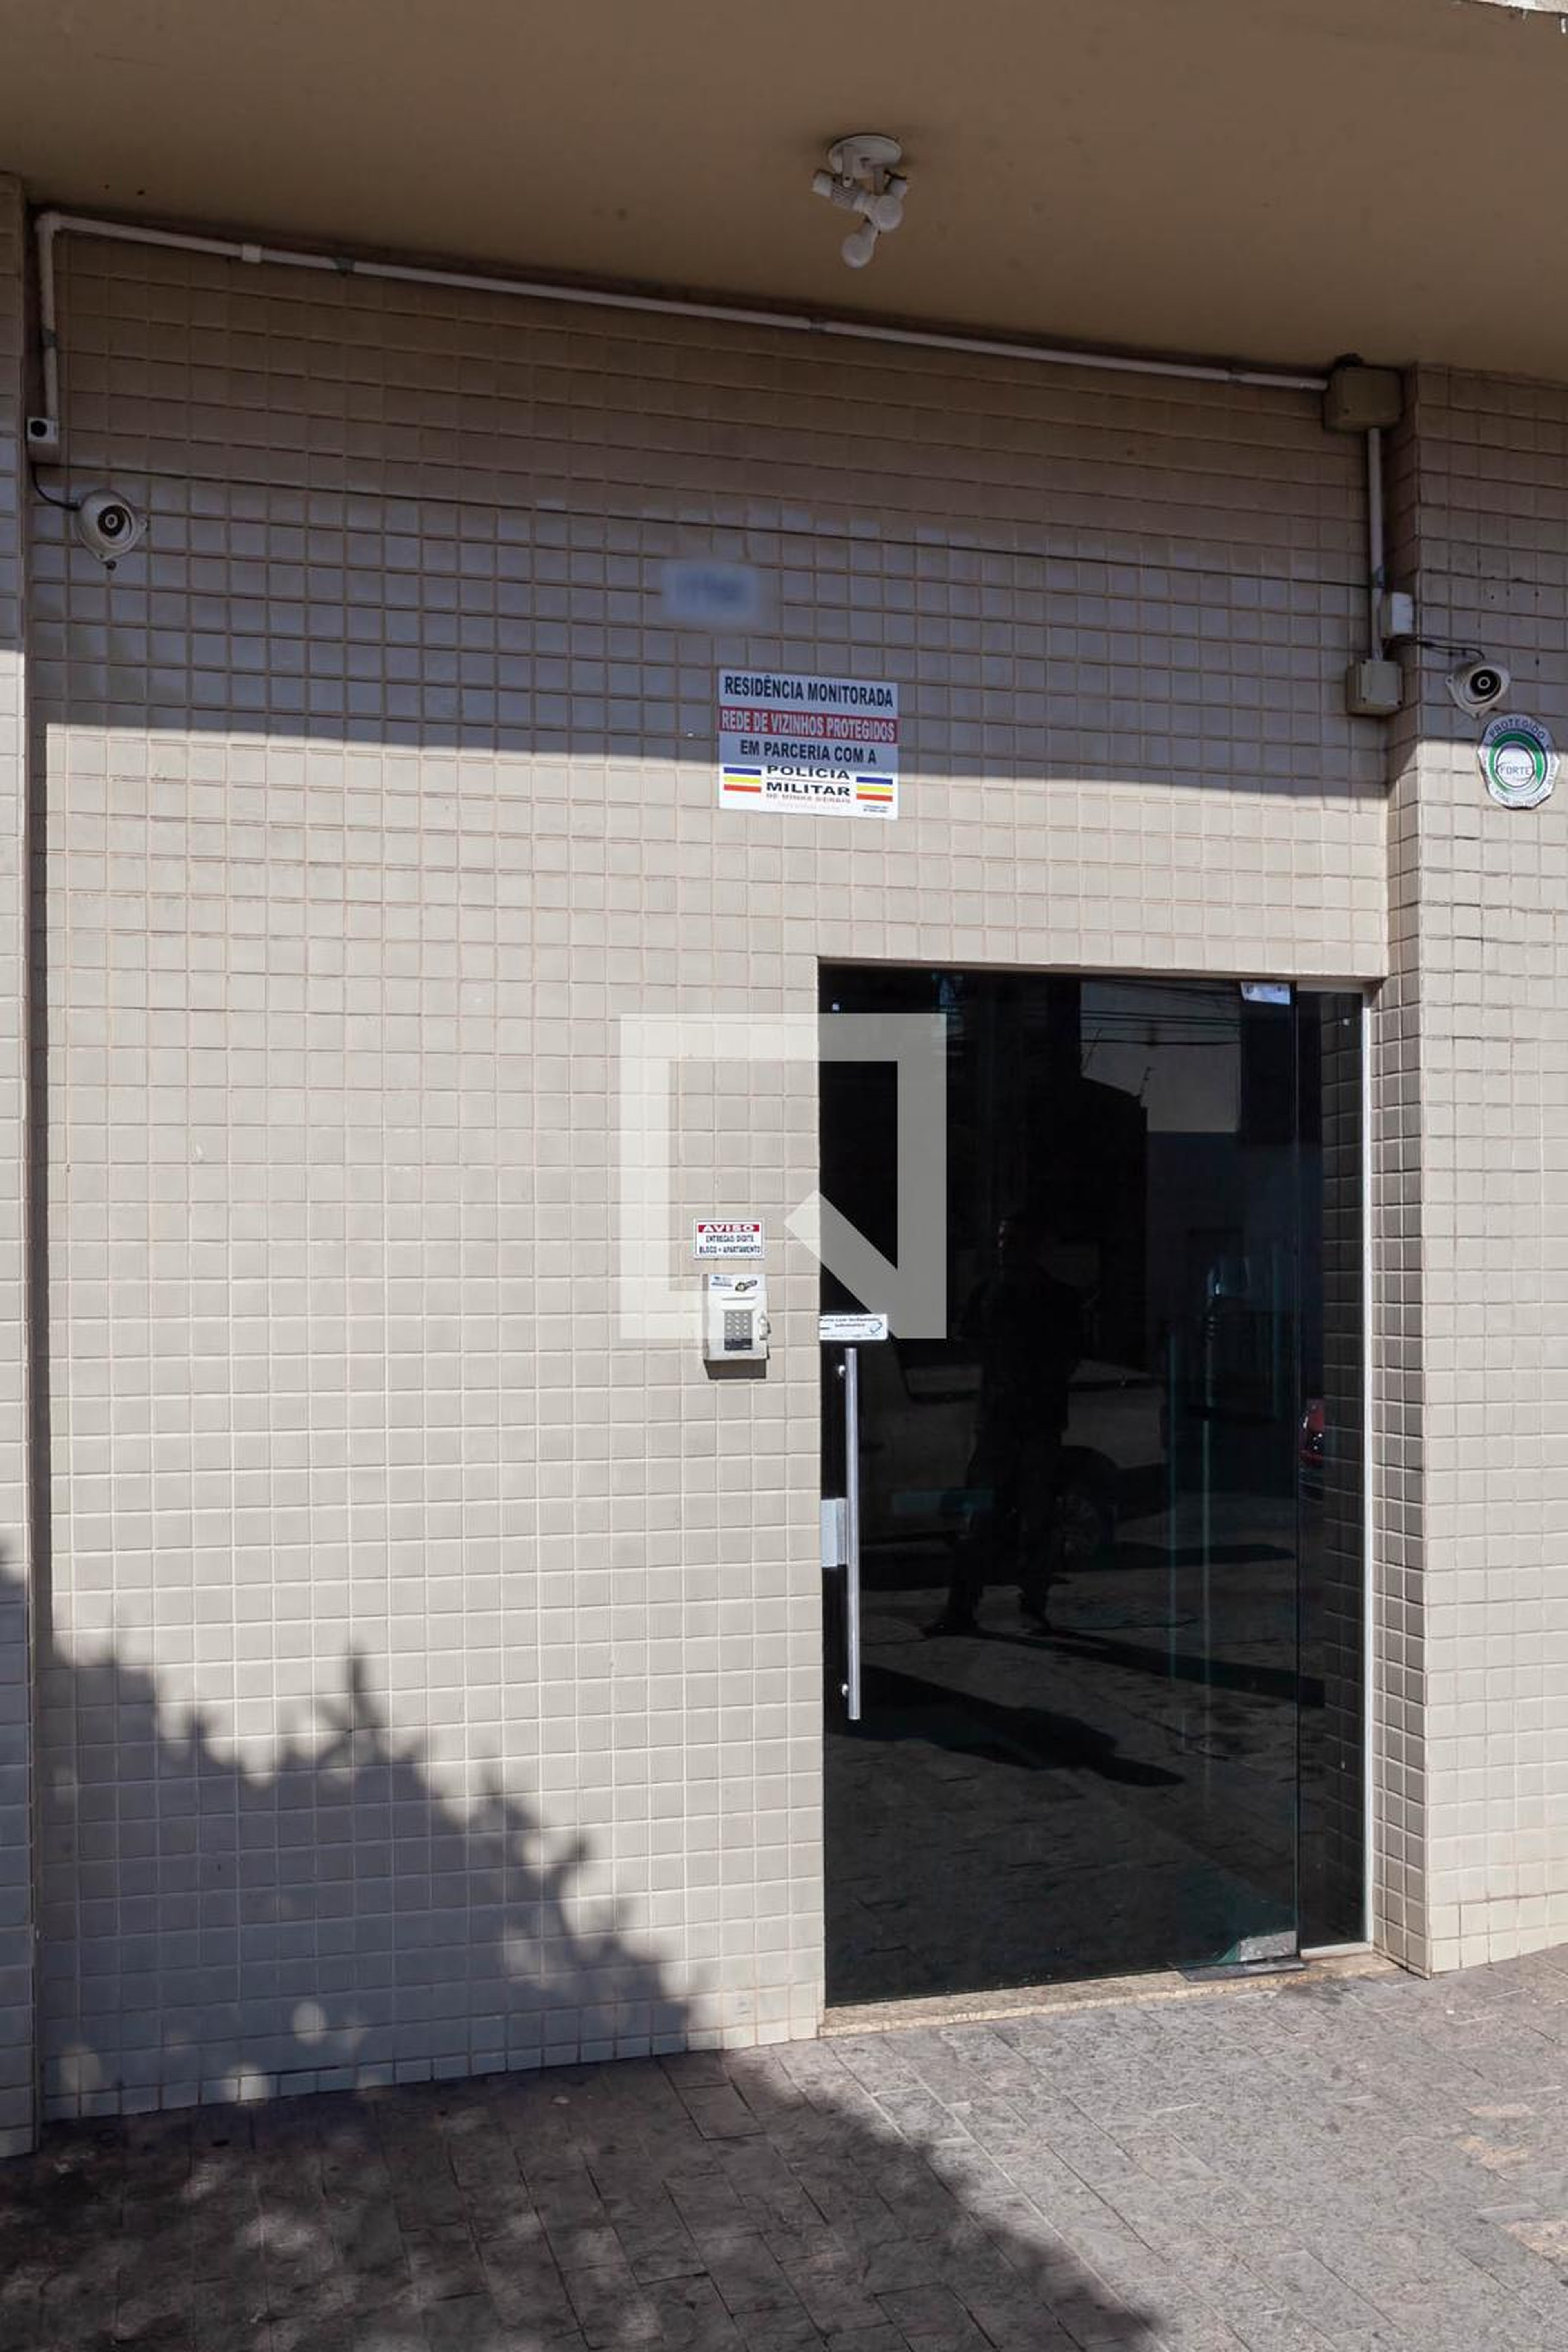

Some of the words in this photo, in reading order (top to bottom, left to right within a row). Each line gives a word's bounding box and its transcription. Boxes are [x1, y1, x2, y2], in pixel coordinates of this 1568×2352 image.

[724, 675, 804, 701] RESIDÊNCIA
[807, 682, 893, 708] MONITORADA
[722, 710, 750, 731] REDE
[753, 712, 768, 732] DE
[771, 713, 824, 736] VIZINHOS
[827, 717, 895, 742] PROTEGIDOS
[1489, 718, 1546, 739] PROTEGIDO
[740, 739, 760, 756] EM
[764, 742, 830, 761] PARCERIA
[834, 747, 864, 763] COM
[868, 750, 877, 764] A
[767, 765, 850, 780] POLÍCIA
[766, 782, 851, 797] MILITAR
[702, 1224, 755, 1233] AVISO
